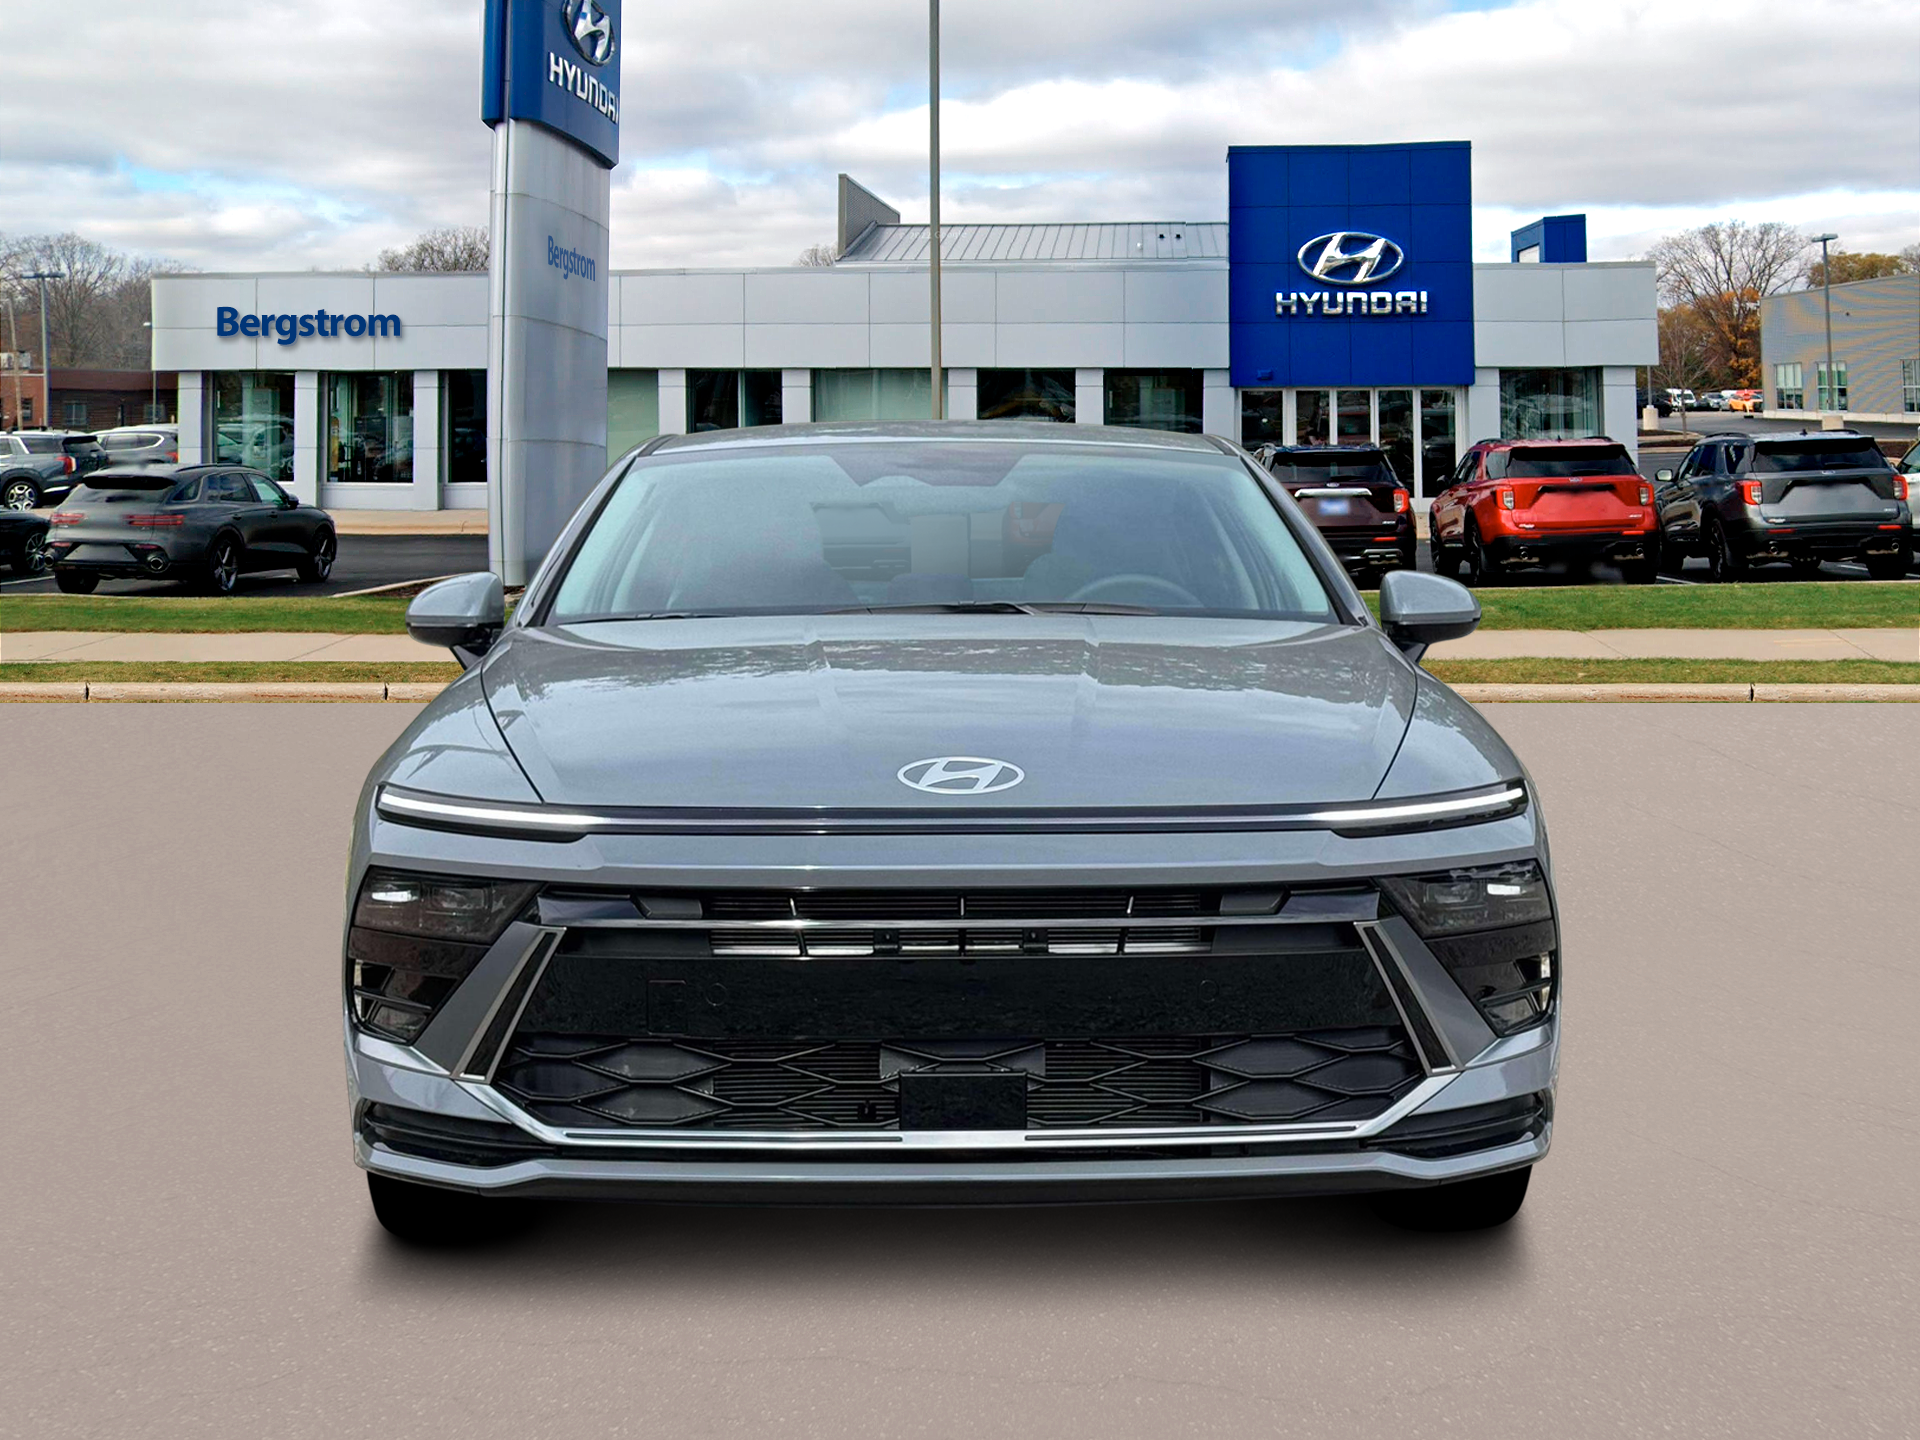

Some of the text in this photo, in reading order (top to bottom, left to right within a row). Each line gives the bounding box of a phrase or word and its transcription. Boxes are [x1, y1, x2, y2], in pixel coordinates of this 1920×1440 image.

[549, 52, 618, 124] HYUNDAI
[548, 235, 595, 281] Bergstrom
[1276, 290, 1427, 315] HYUNDAI
[217, 306, 401, 345] Bergstrom
